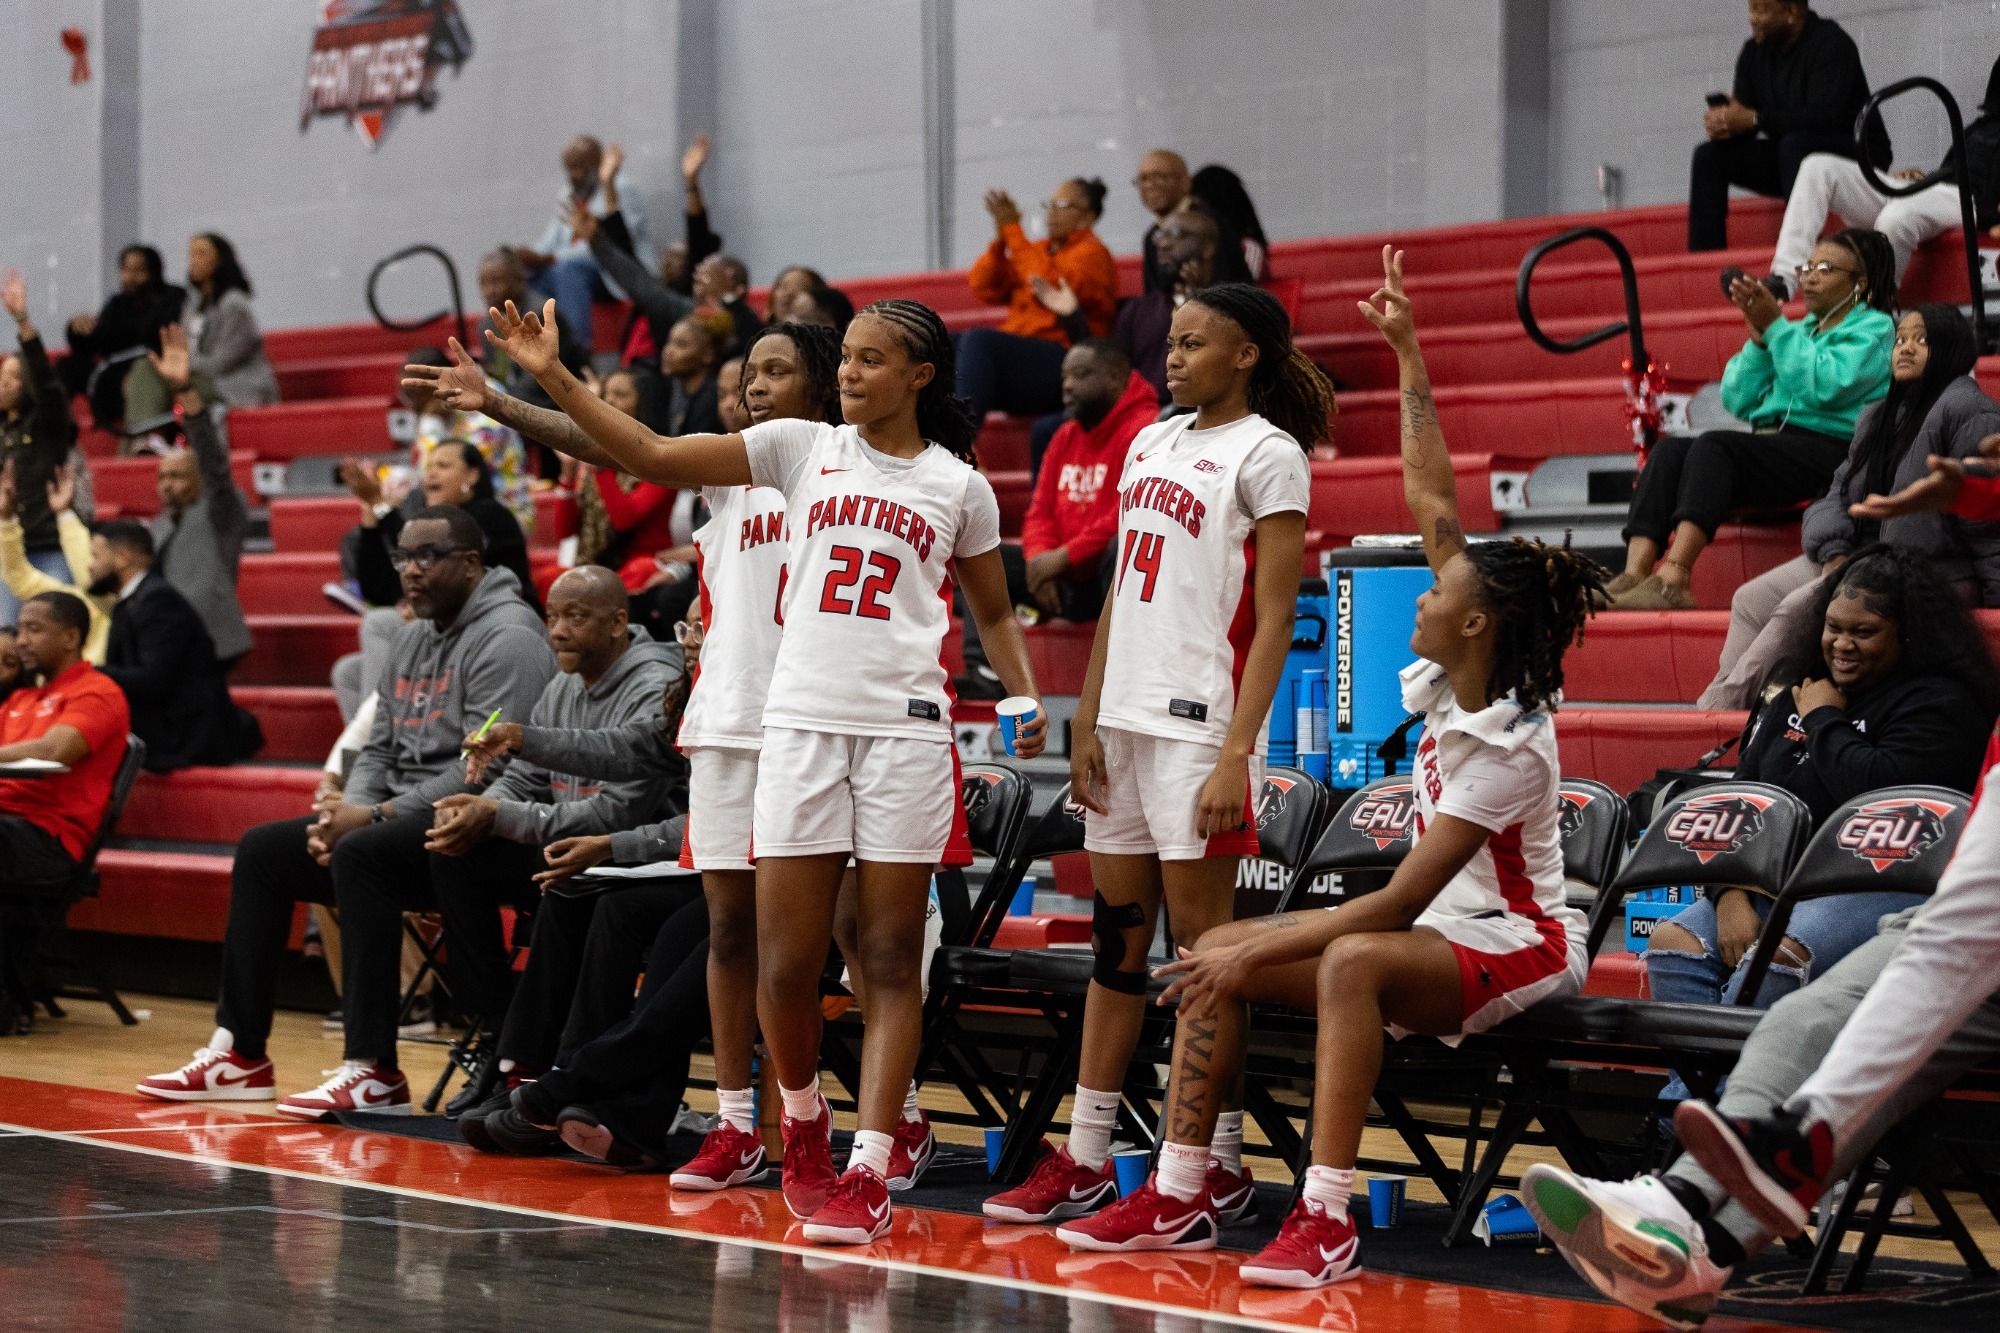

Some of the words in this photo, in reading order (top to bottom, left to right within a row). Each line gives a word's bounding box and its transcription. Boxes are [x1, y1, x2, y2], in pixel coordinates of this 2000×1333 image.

[806, 494, 936, 563] PANTHERS
[819, 544, 901, 621] 22
[1117, 529, 1165, 603] 14
[1337, 578, 1351, 725] POWERADE
[1667, 809, 1744, 841] CAU
[1840, 816, 1922, 849] CAU
